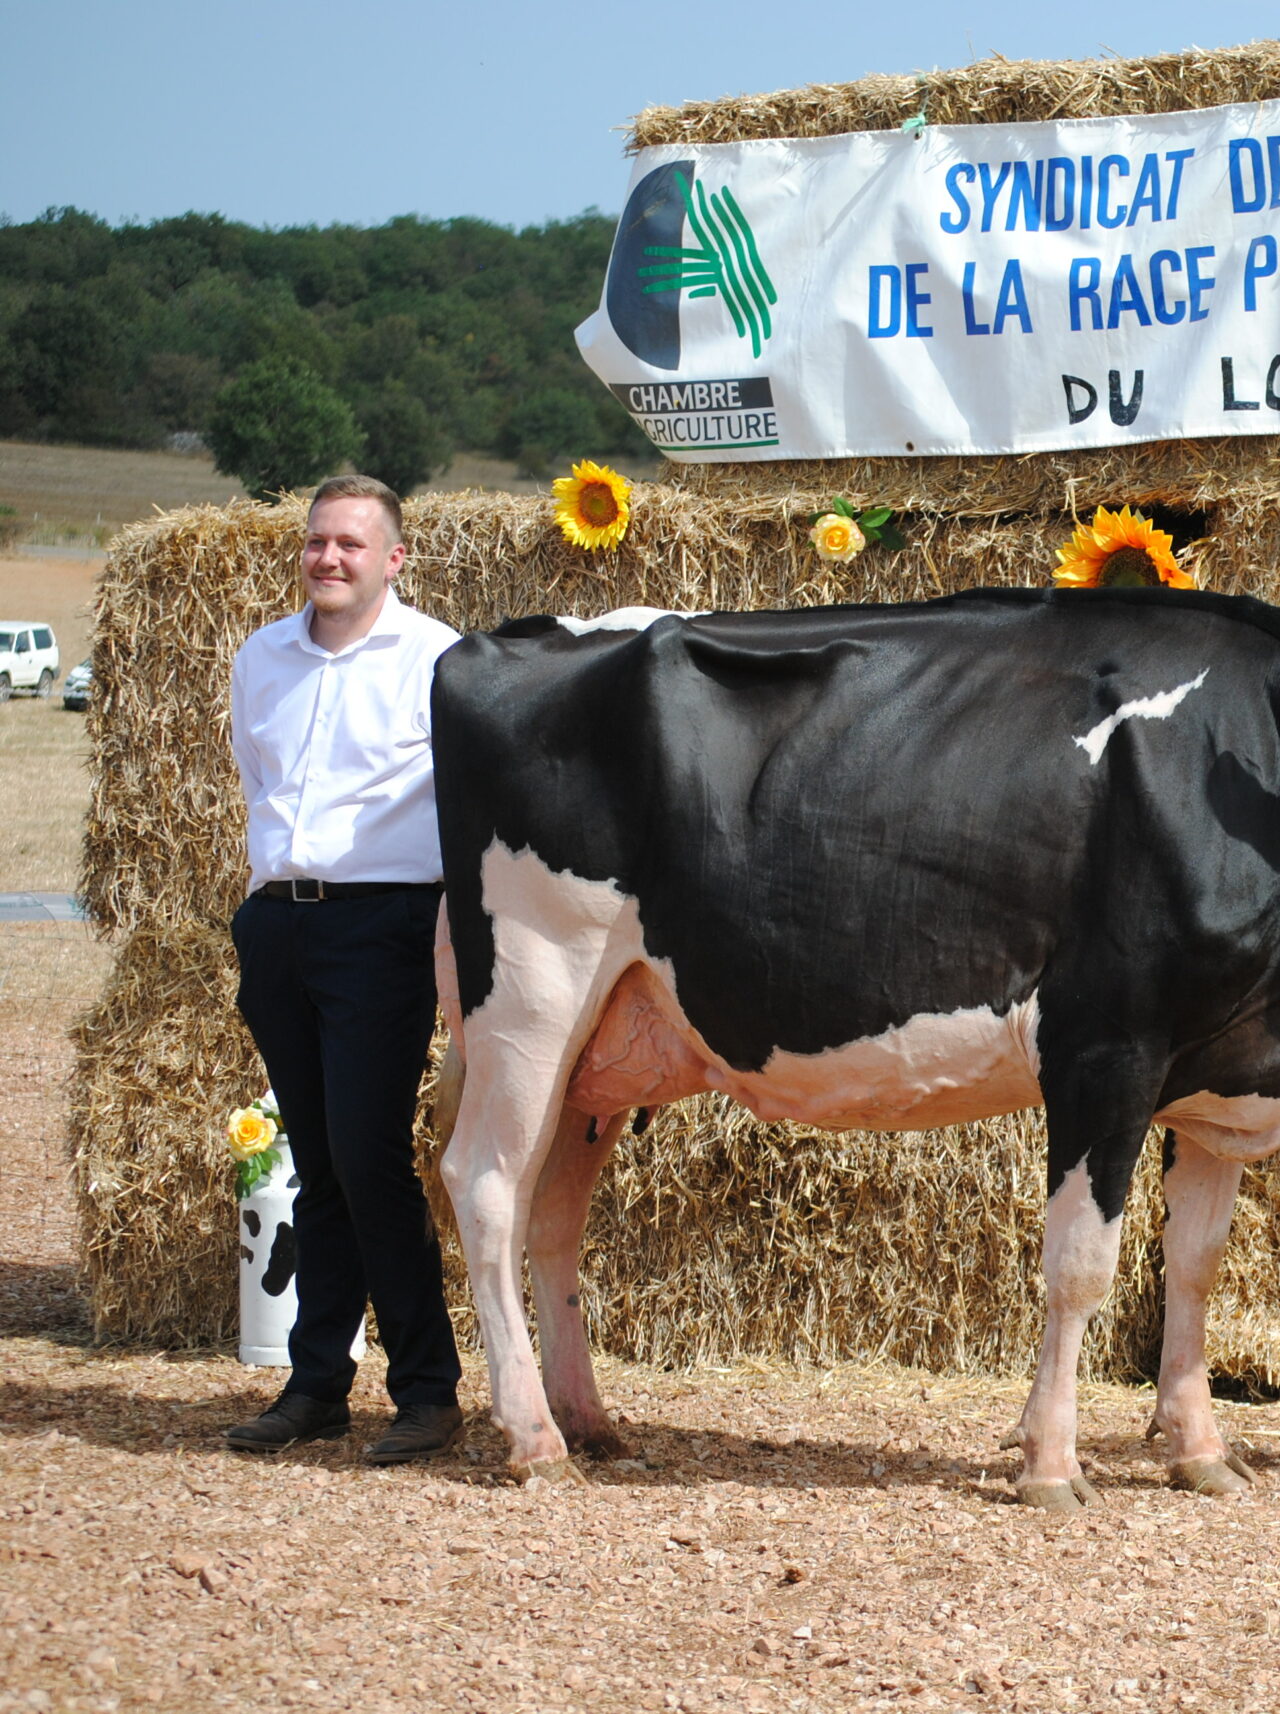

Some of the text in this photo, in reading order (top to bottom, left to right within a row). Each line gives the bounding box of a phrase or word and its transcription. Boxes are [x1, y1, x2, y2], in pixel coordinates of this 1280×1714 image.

[939, 148, 1196, 235] SYNDICAT
[867, 264, 933, 339] DE
[962, 259, 1033, 336] LA
[1069, 246, 1217, 331] RACE
[629, 381, 742, 412] CHAMBRE
[1062, 370, 1144, 427] DU
